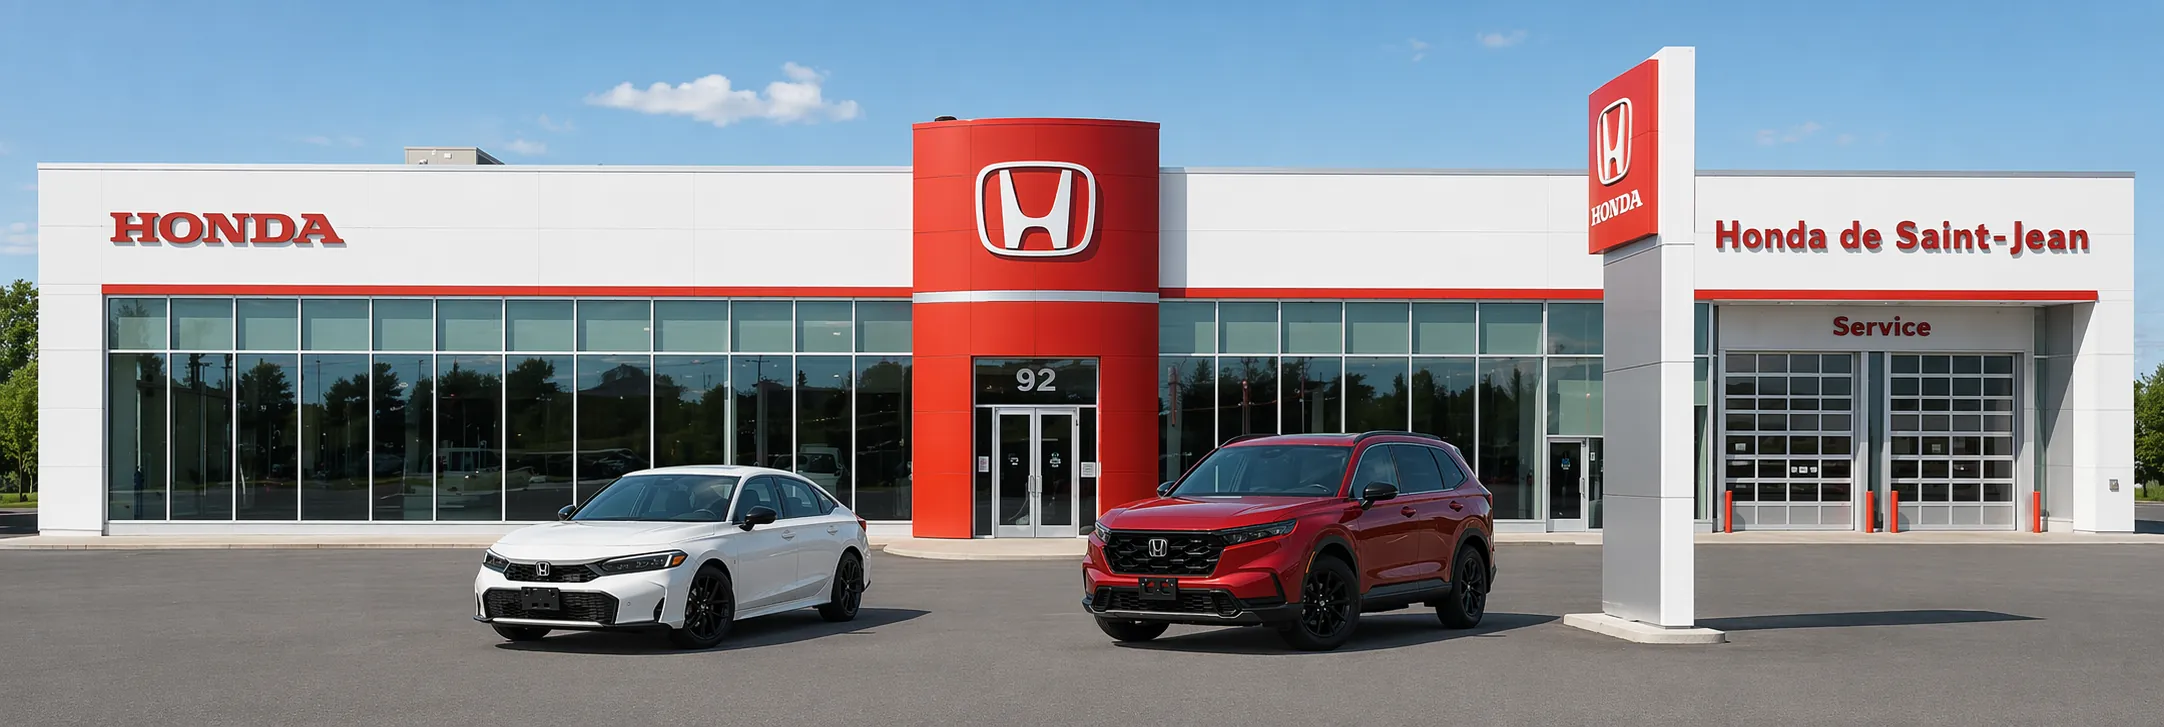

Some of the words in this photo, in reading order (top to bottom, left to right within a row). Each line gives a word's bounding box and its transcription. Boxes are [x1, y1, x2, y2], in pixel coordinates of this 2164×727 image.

[1591, 189, 1643, 226] HONDA
[110, 212, 344, 245] HONDA
[1715, 220, 1826, 249] Honda
[1840, 220, 1881, 249] de
[1895, 220, 2089, 256] Saint-Jean
[1833, 316, 1931, 337] Service
[1016, 368, 1056, 392] 92
